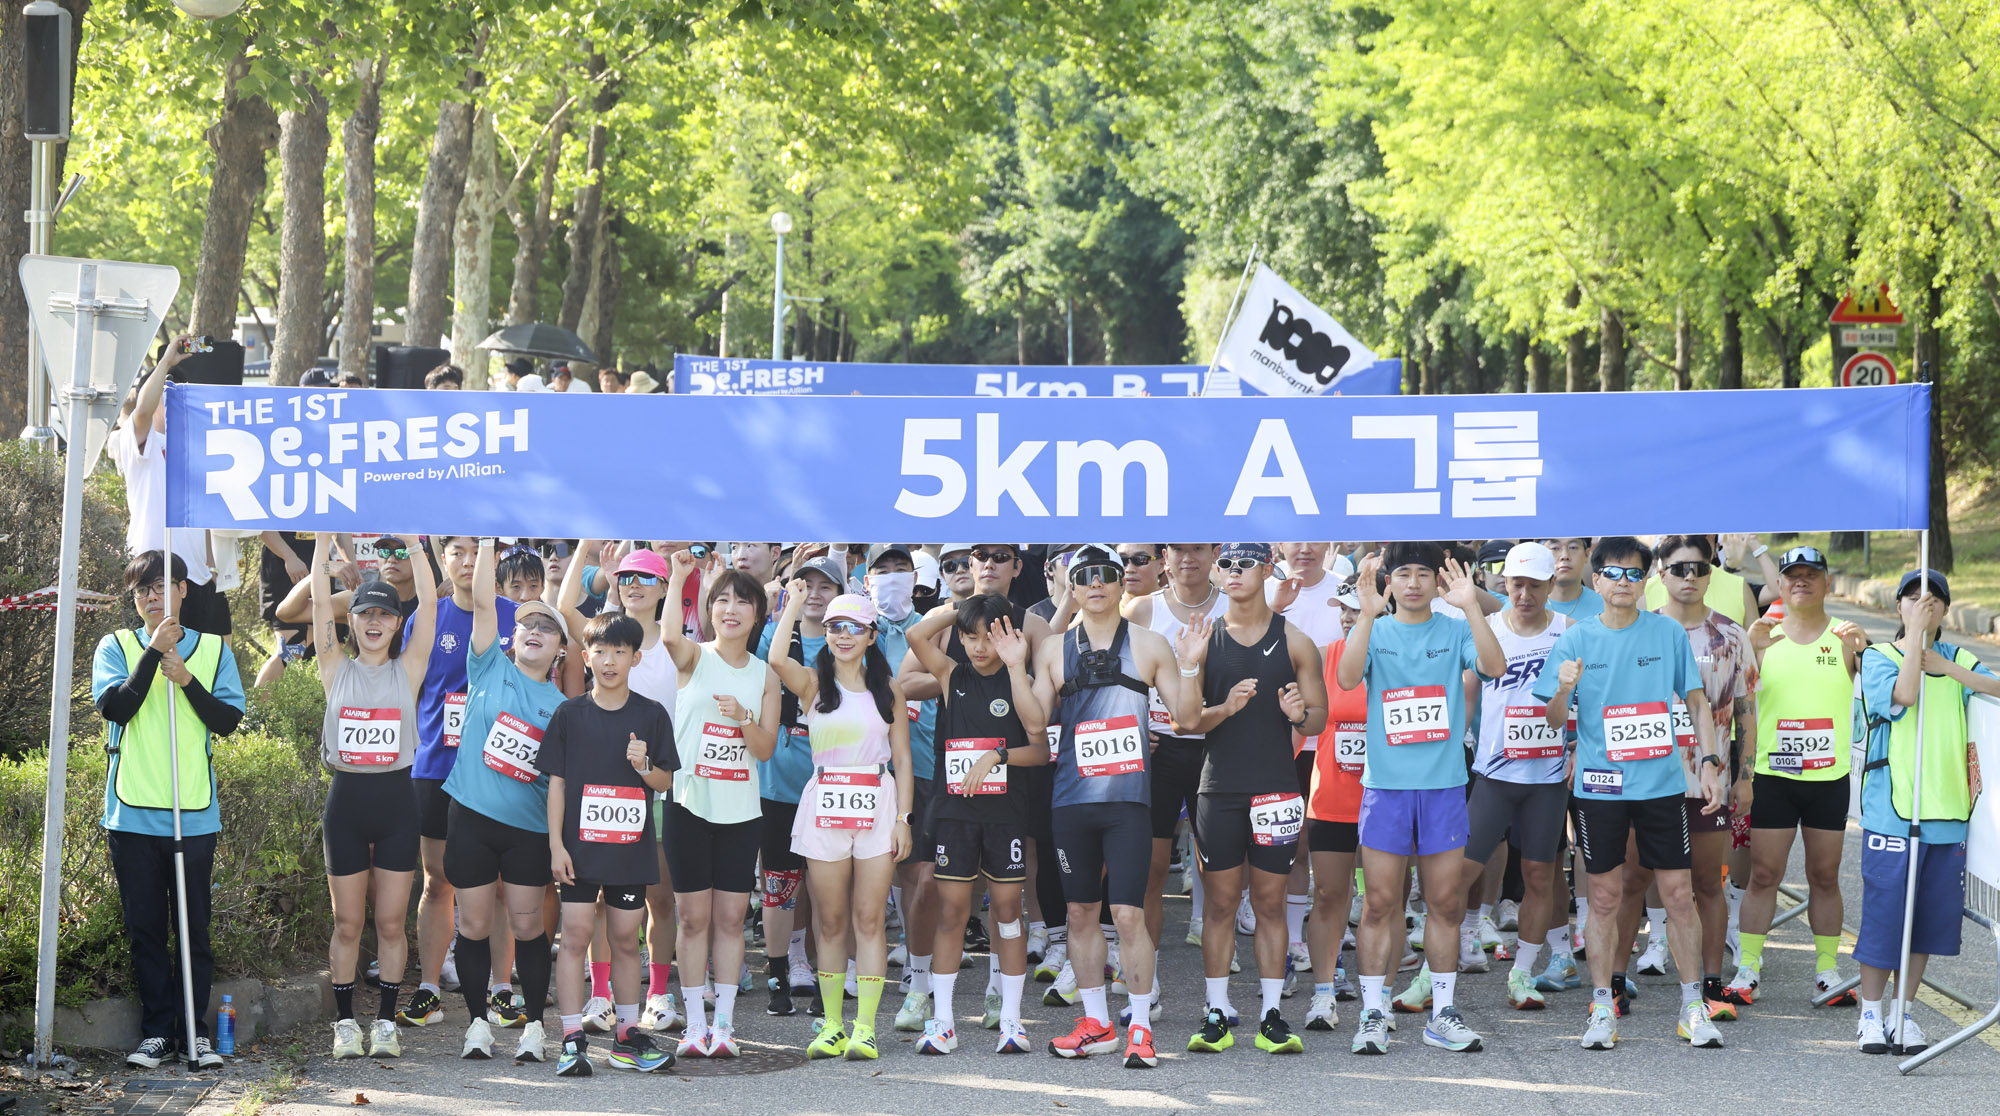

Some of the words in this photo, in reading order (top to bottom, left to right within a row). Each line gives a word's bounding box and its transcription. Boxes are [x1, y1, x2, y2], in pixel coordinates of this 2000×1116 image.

[690, 361, 719, 373] THE
[723, 360, 750, 371] 1ST
[1856, 366, 1883, 386] 20
[205, 398, 274, 425] THE
[287, 392, 349, 422] 1ST
[894, 413, 1169, 518] 5km
[1224, 418, 1320, 516] A
[1346, 411, 1543, 518] 그룹
[364, 469, 425, 483] Powered
[428, 467, 445, 481] by
[1508, 654, 1526, 662] SPEED
[1820, 646, 1832, 654] W
[1389, 704, 1443, 726] 5157
[343, 727, 396, 745] 7020
[1508, 724, 1558, 741] 5073
[1611, 721, 1667, 742] 5258
[703, 743, 747, 762] 5257
[1081, 734, 1137, 759] 5016
[1781, 736, 1830, 753] 5592
[1126, 763, 1138, 771] km
[1775, 757, 1797, 766] 0105
[519, 772, 531, 782] km
[1589, 774, 1615, 784] 0124
[988, 784, 1001, 792] km
[822, 791, 876, 810] 5163
[586, 804, 641, 824] 5003
[1256, 805, 1303, 827] 5138
[1010, 838, 1023, 863] 6
[1867, 834, 1907, 853] 03
